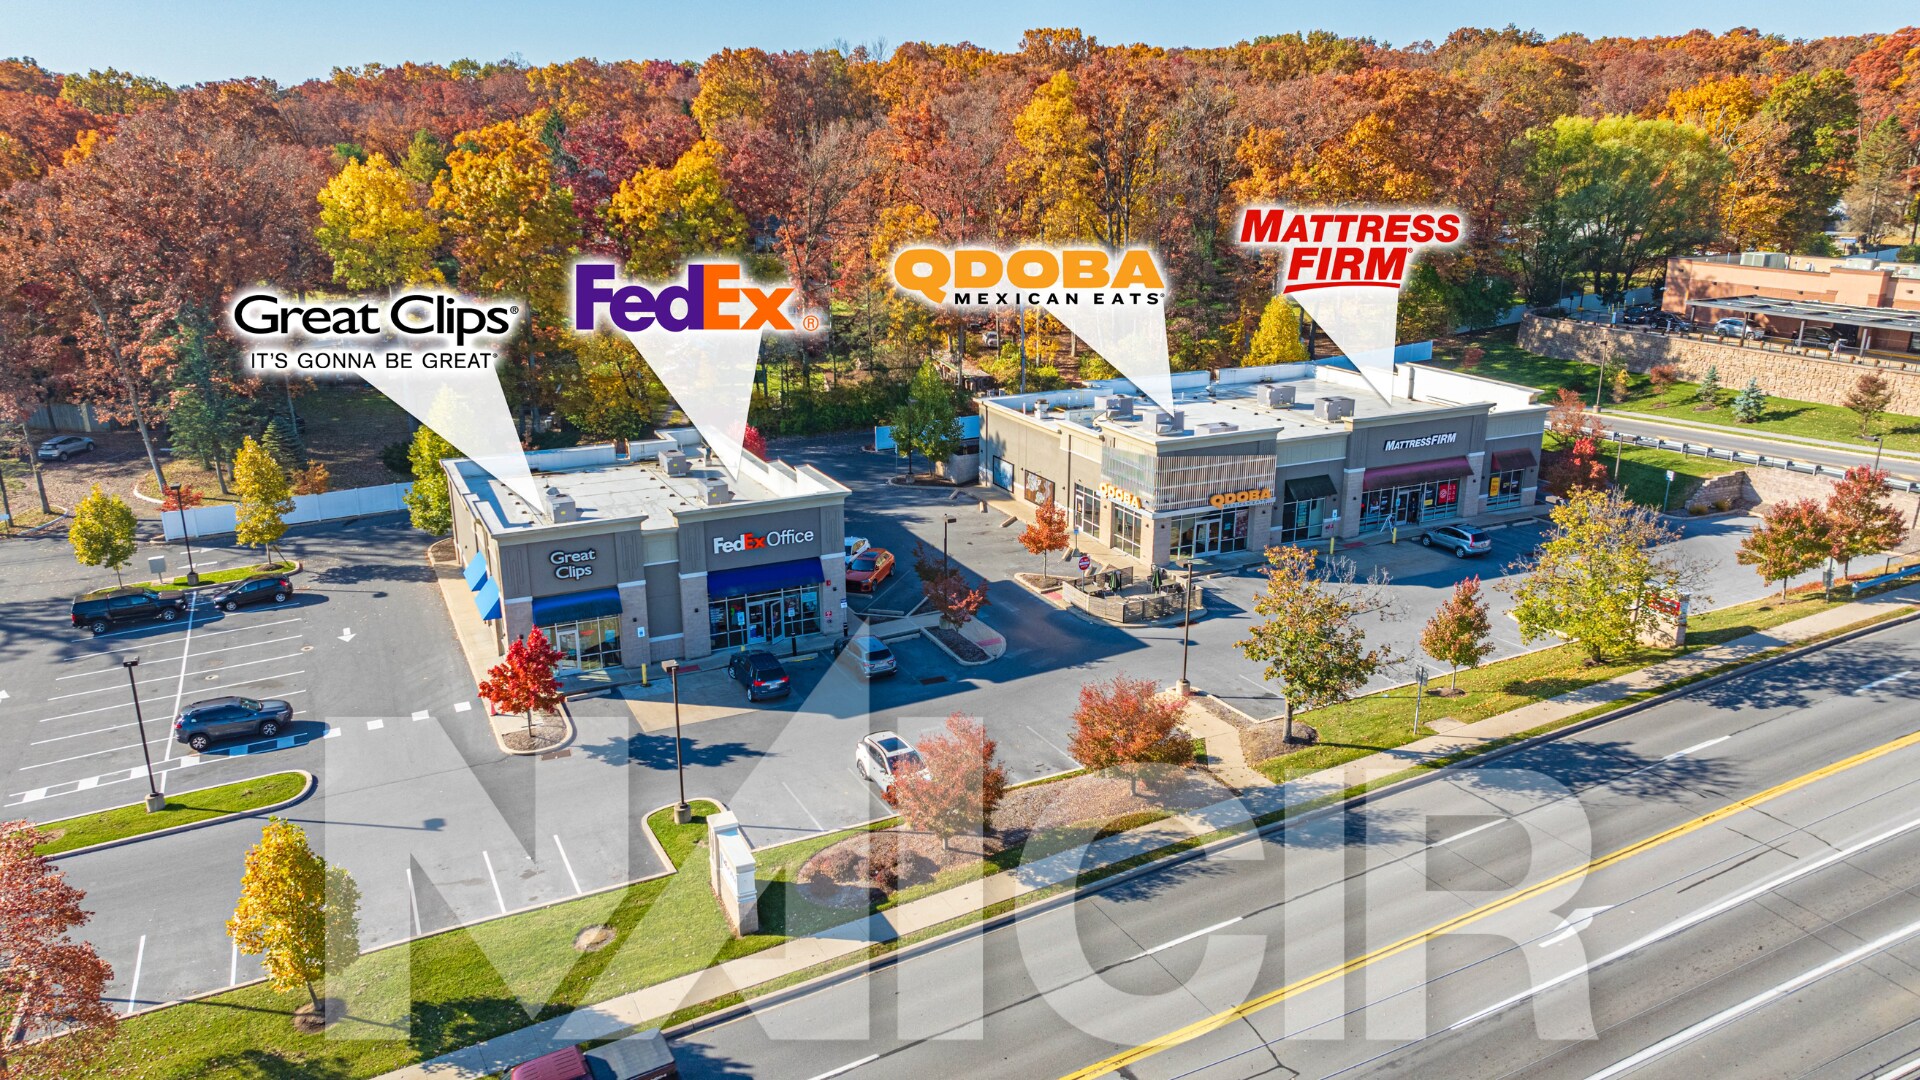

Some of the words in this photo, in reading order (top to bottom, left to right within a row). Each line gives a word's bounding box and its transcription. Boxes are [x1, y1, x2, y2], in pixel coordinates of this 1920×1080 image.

[1098, 482, 1142, 509] QDOBA
[1210, 488, 1271, 510] QDOBA
[713, 532, 766, 554] FedEx
[766, 529, 815, 547] Office
[550, 549, 596, 565] Great
[555, 565, 593, 580] Clips
